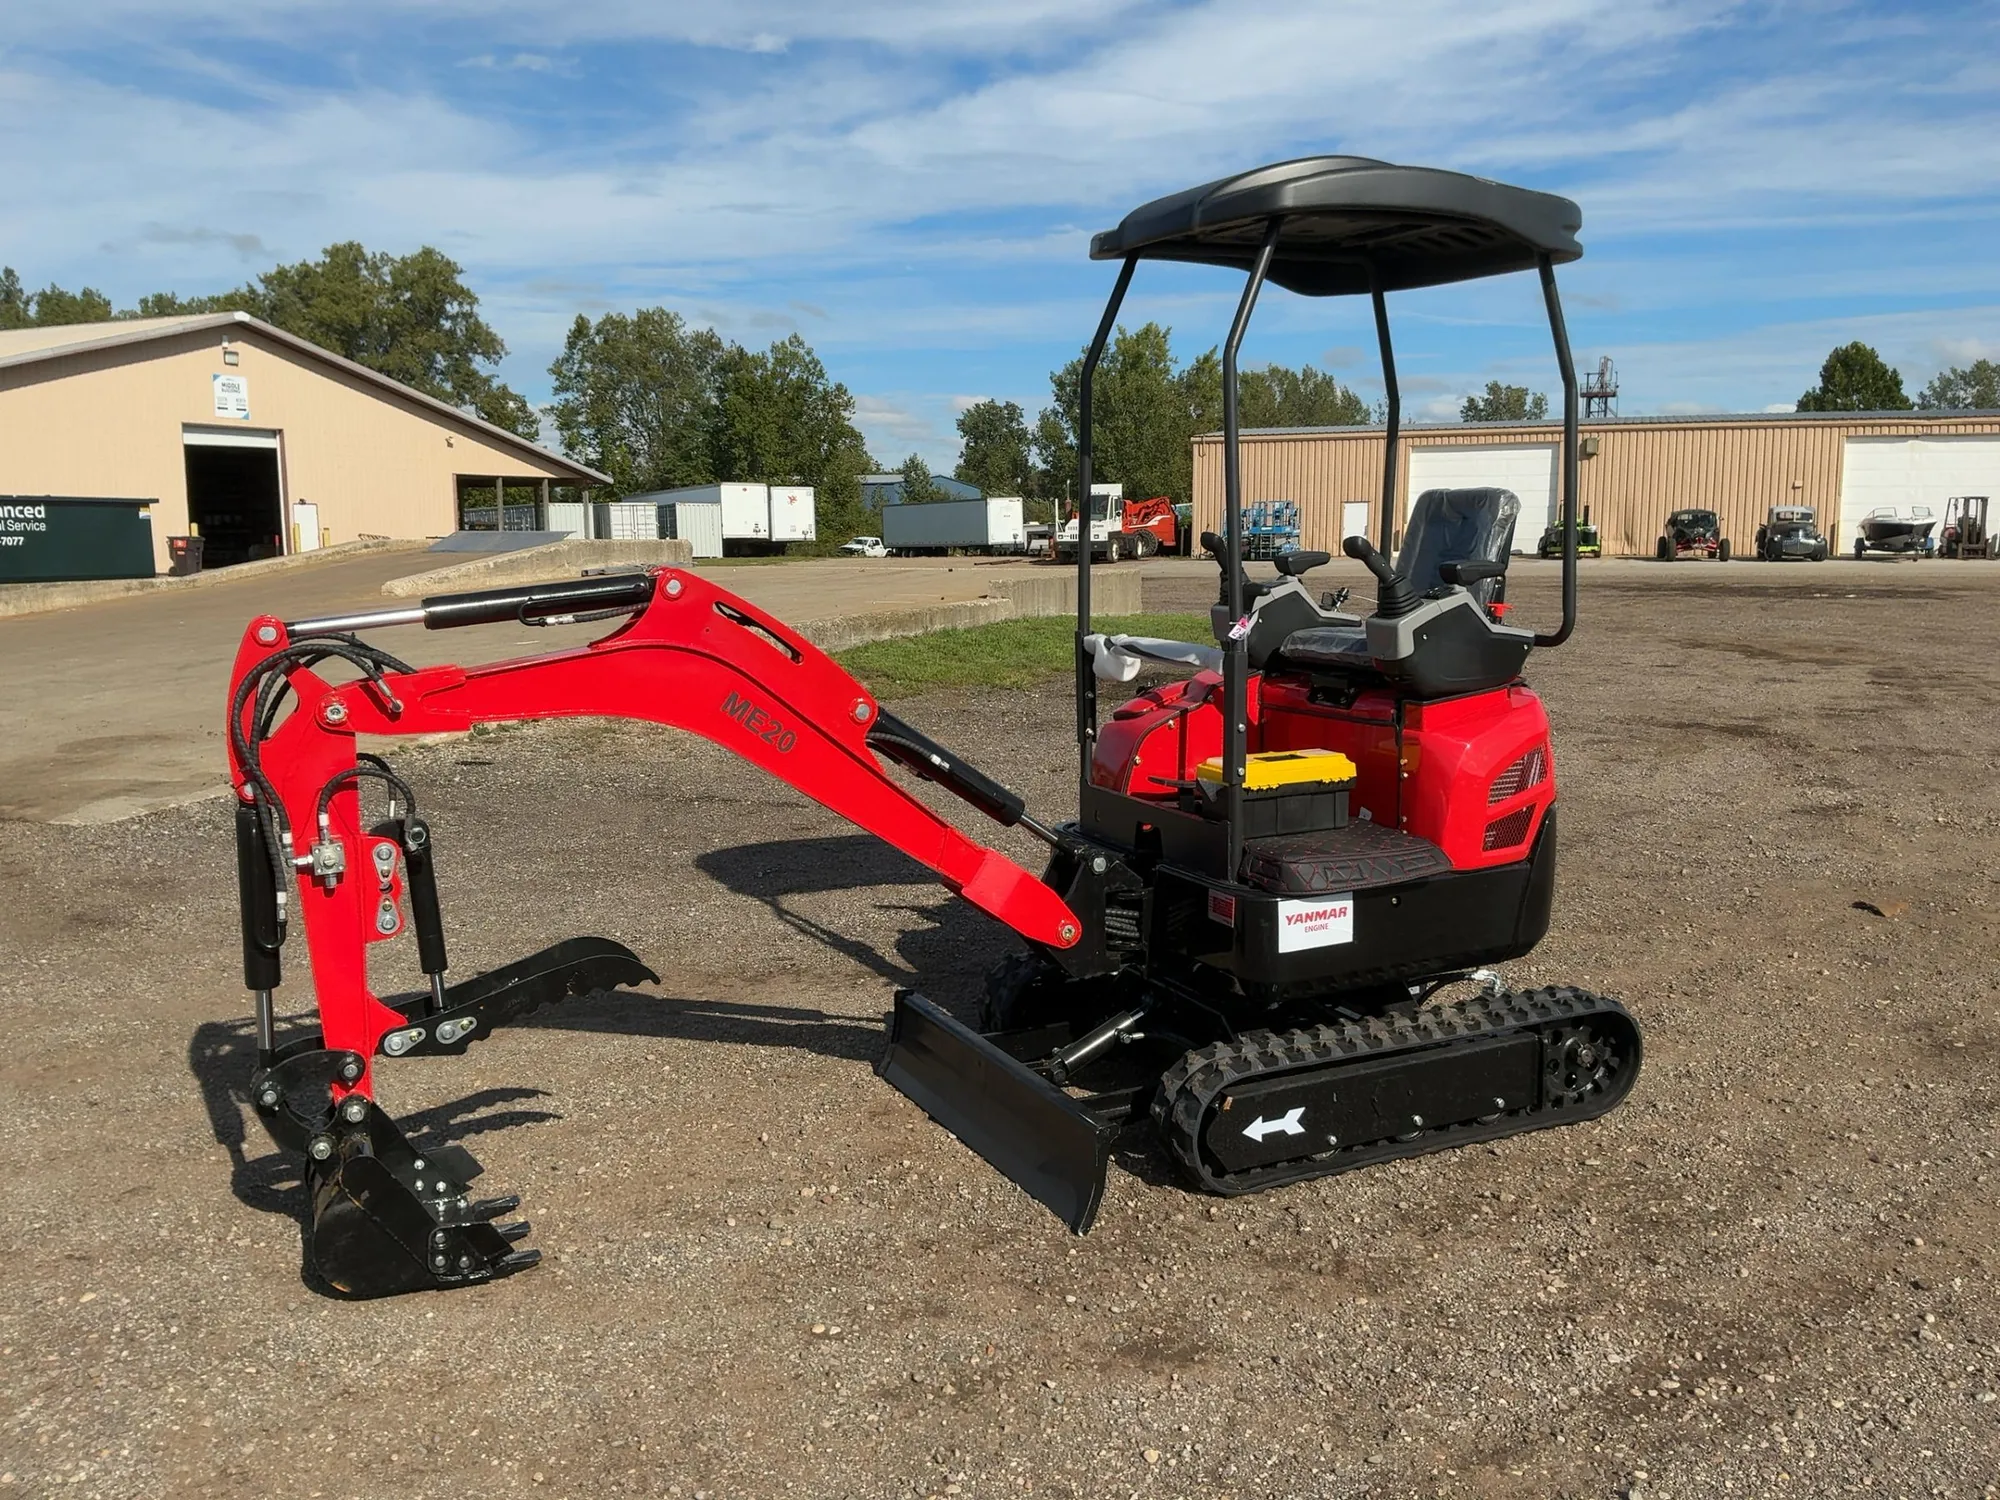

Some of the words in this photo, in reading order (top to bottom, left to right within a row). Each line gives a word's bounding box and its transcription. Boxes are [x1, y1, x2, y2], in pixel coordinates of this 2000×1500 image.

[0, 519, 6, 531] l
[6, 519, 47, 531] Service
[721, 691, 797, 752] ME20
[1285, 906, 1348, 926] YANMAR
[1304, 923, 1329, 933] ENGINE
